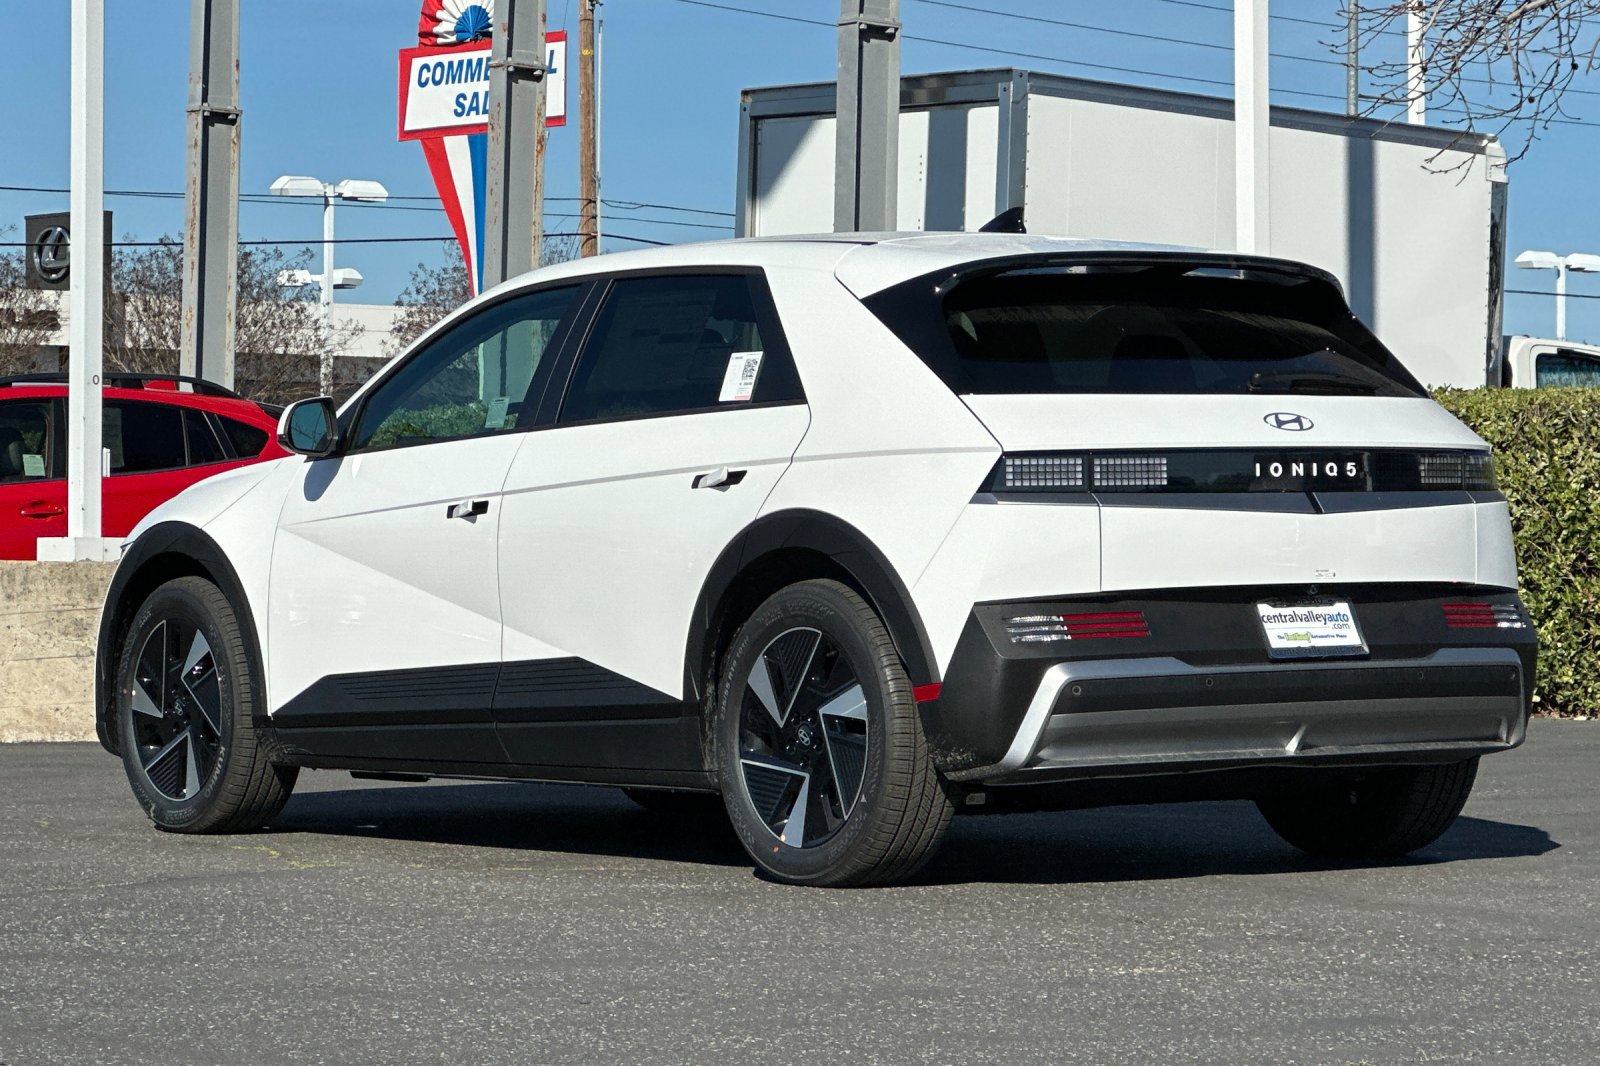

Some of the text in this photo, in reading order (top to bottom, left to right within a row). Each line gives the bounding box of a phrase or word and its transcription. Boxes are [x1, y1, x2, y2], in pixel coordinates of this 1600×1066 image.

[417, 49, 557, 88] COMMEL
[453, 91, 489, 117] SAL
[1261, 610, 1349, 625] centralvalleyauto
